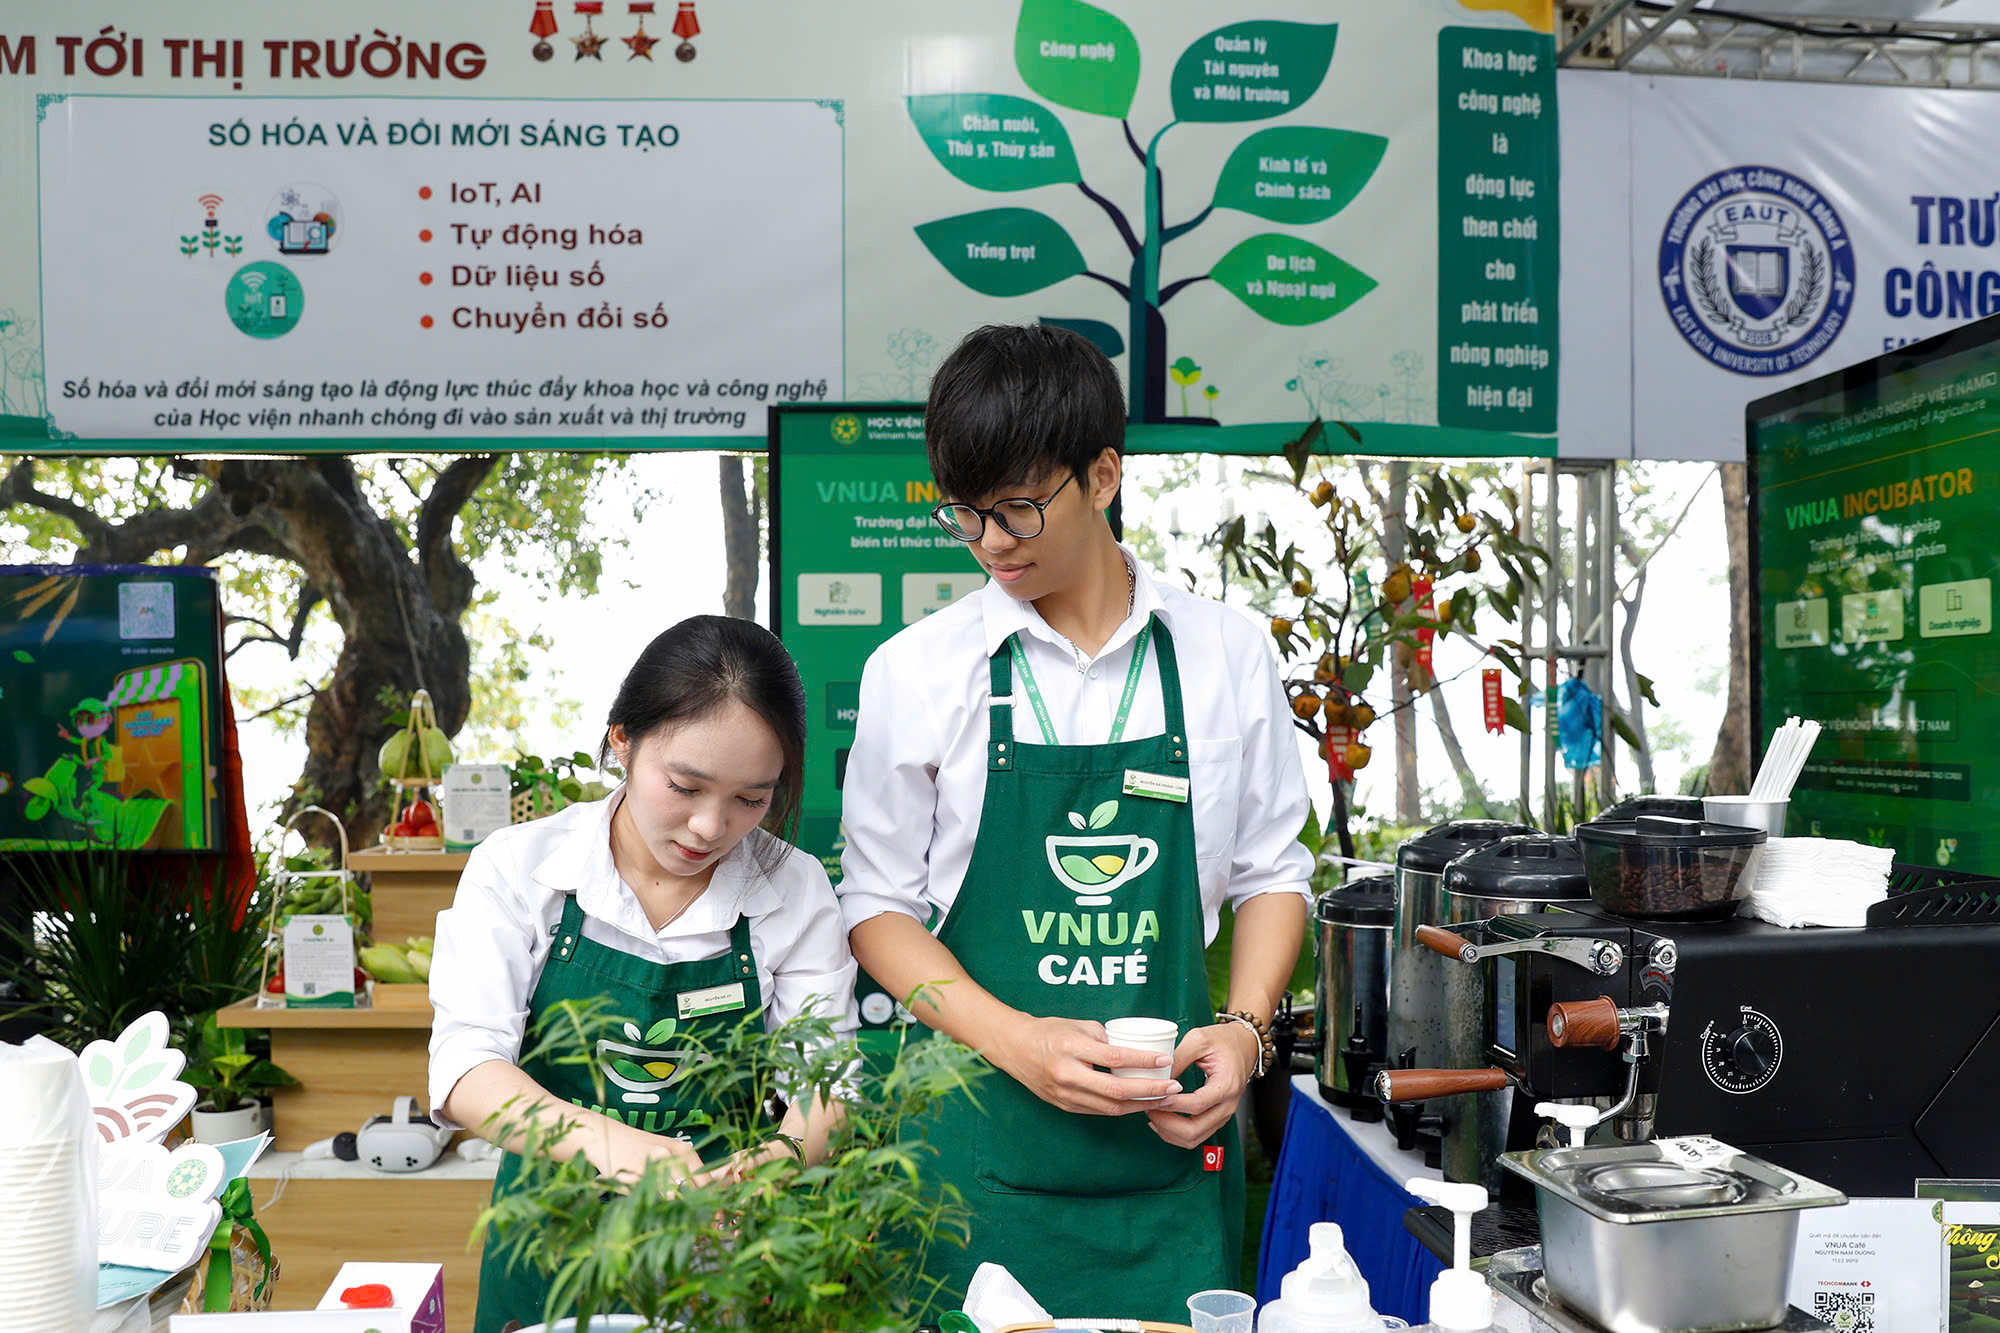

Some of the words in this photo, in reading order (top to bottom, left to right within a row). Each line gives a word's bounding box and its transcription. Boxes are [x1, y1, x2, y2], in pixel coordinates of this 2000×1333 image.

[1040, 40, 1076, 59] Công
[1080, 41, 1115, 62] nghệ
[1215, 34, 1250, 54] Quản
[56, 24, 144, 77] TỚI
[163, 38, 245, 91] THỊ
[263, 27, 488, 80] TRƯỜNG
[1203, 59, 1225, 75] Tài
[1228, 61, 1279, 79] nguyên
[1462, 47, 1503, 71] Khoa
[1507, 49, 1537, 76] học
[1193, 84, 1211, 100] và
[1214, 84, 1241, 101] Môi
[1458, 89, 1498, 114] công
[1502, 92, 1542, 119] nghệ
[208, 117, 251, 146] SỐ
[262, 116, 328, 146] HÓA
[336, 116, 377, 146] VÀ
[387, 117, 441, 146] ĐỔI
[451, 117, 509, 147] MỚI
[520, 118, 607, 147] SÁNG
[616, 124, 680, 153] TẠO
[1492, 132, 1508, 154] là
[1029, 139, 1056, 158] sản
[1259, 156, 1291, 173] Kinh
[1294, 155, 1308, 174] tế
[1311, 159, 1328, 175] và
[451, 182, 501, 207] IoT,
[512, 183, 541, 203] AI
[1255, 181, 1295, 199] Chính
[1298, 184, 1331, 200] sách
[1465, 174, 1505, 199] động
[1510, 177, 1535, 201] lực
[1724, 203, 1790, 225] EAUT
[1911, 192, 2000, 247] TRƯ
[451, 224, 493, 249] Tự
[502, 223, 579, 250] động
[589, 223, 644, 246] hóa
[1463, 216, 1498, 239] then
[1502, 216, 1538, 241] chốt
[966, 240, 1006, 262] Trồng
[452, 263, 496, 287] Dữ
[506, 265, 559, 291] liệu
[569, 260, 606, 287] số
[1267, 255, 1287, 271] Du
[1289, 255, 1316, 275] lịch
[1485, 259, 1515, 281] cho
[1247, 280, 1264, 296] và
[1266, 279, 1307, 300] Ngoại
[1885, 259, 2000, 320] CÔNG
[452, 301, 567, 334] Chuyển
[577, 301, 623, 329] đổi
[633, 302, 670, 329] số
[1462, 300, 1499, 324] phát
[1501, 297, 1538, 324] triển
[1672, 304, 1698, 334] EAST
[1689, 331, 1715, 355] ASIA
[1712, 344, 1775, 373] UNIVERSITY
[1775, 356, 1792, 371] OF
[1790, 309, 1844, 365] TECHNOLOGY
[1450, 343, 1491, 366] nông
[1494, 344, 1549, 371] nghiệp
[62, 377, 91, 399] Số
[99, 379, 137, 399] hóa
[144, 380, 168, 399] và
[176, 377, 209, 400] đổi
[215, 379, 256, 399] mới
[263, 380, 314, 403] sáng
[320, 381, 353, 402] tạo
[360, 379, 378, 399] là
[385, 379, 438, 402] động
[445, 379, 480, 401] lực
[486, 379, 532, 398] thúc
[539, 376, 577, 400] đẩy
[583, 379, 634, 398] khoa
[641, 379, 679, 401] học
[686, 379, 713, 398] và
[717, 380, 769, 403] công
[775, 379, 828, 402] nghệ
[1467, 385, 1503, 411] hiện
[1507, 386, 1533, 413] đại
[154, 408, 192, 428] của
[199, 408, 241, 430] Học
[249, 408, 292, 430] viện
[299, 409, 365, 428] nhanh
[370, 408, 437, 430] chóng
[443, 407, 463, 426] đi
[470, 408, 508, 426] vào
[514, 407, 552, 425] sản
[558, 404, 604, 425] xuất
[612, 406, 635, 425] và
[640, 406, 669, 428] thị
[673, 407, 746, 429] trường
[867, 417, 893, 430] HỌC
[895, 415, 922, 429] VIỆN
[816, 480, 899, 504] VNUA
[1785, 497, 1840, 530] VNUA
[1843, 467, 1974, 519] INCUBATOR
[854, 515, 904, 531] Trường
[906, 515, 927, 530] đại
[851, 534, 881, 549] biến
[899, 535, 933, 549] thức
[1130, 666, 1139, 688] NATIONAL
[1021, 910, 1160, 945] VNUA
[1037, 948, 1148, 986] CAFÉ
[1942, 1221, 1997, 1253] Thông
